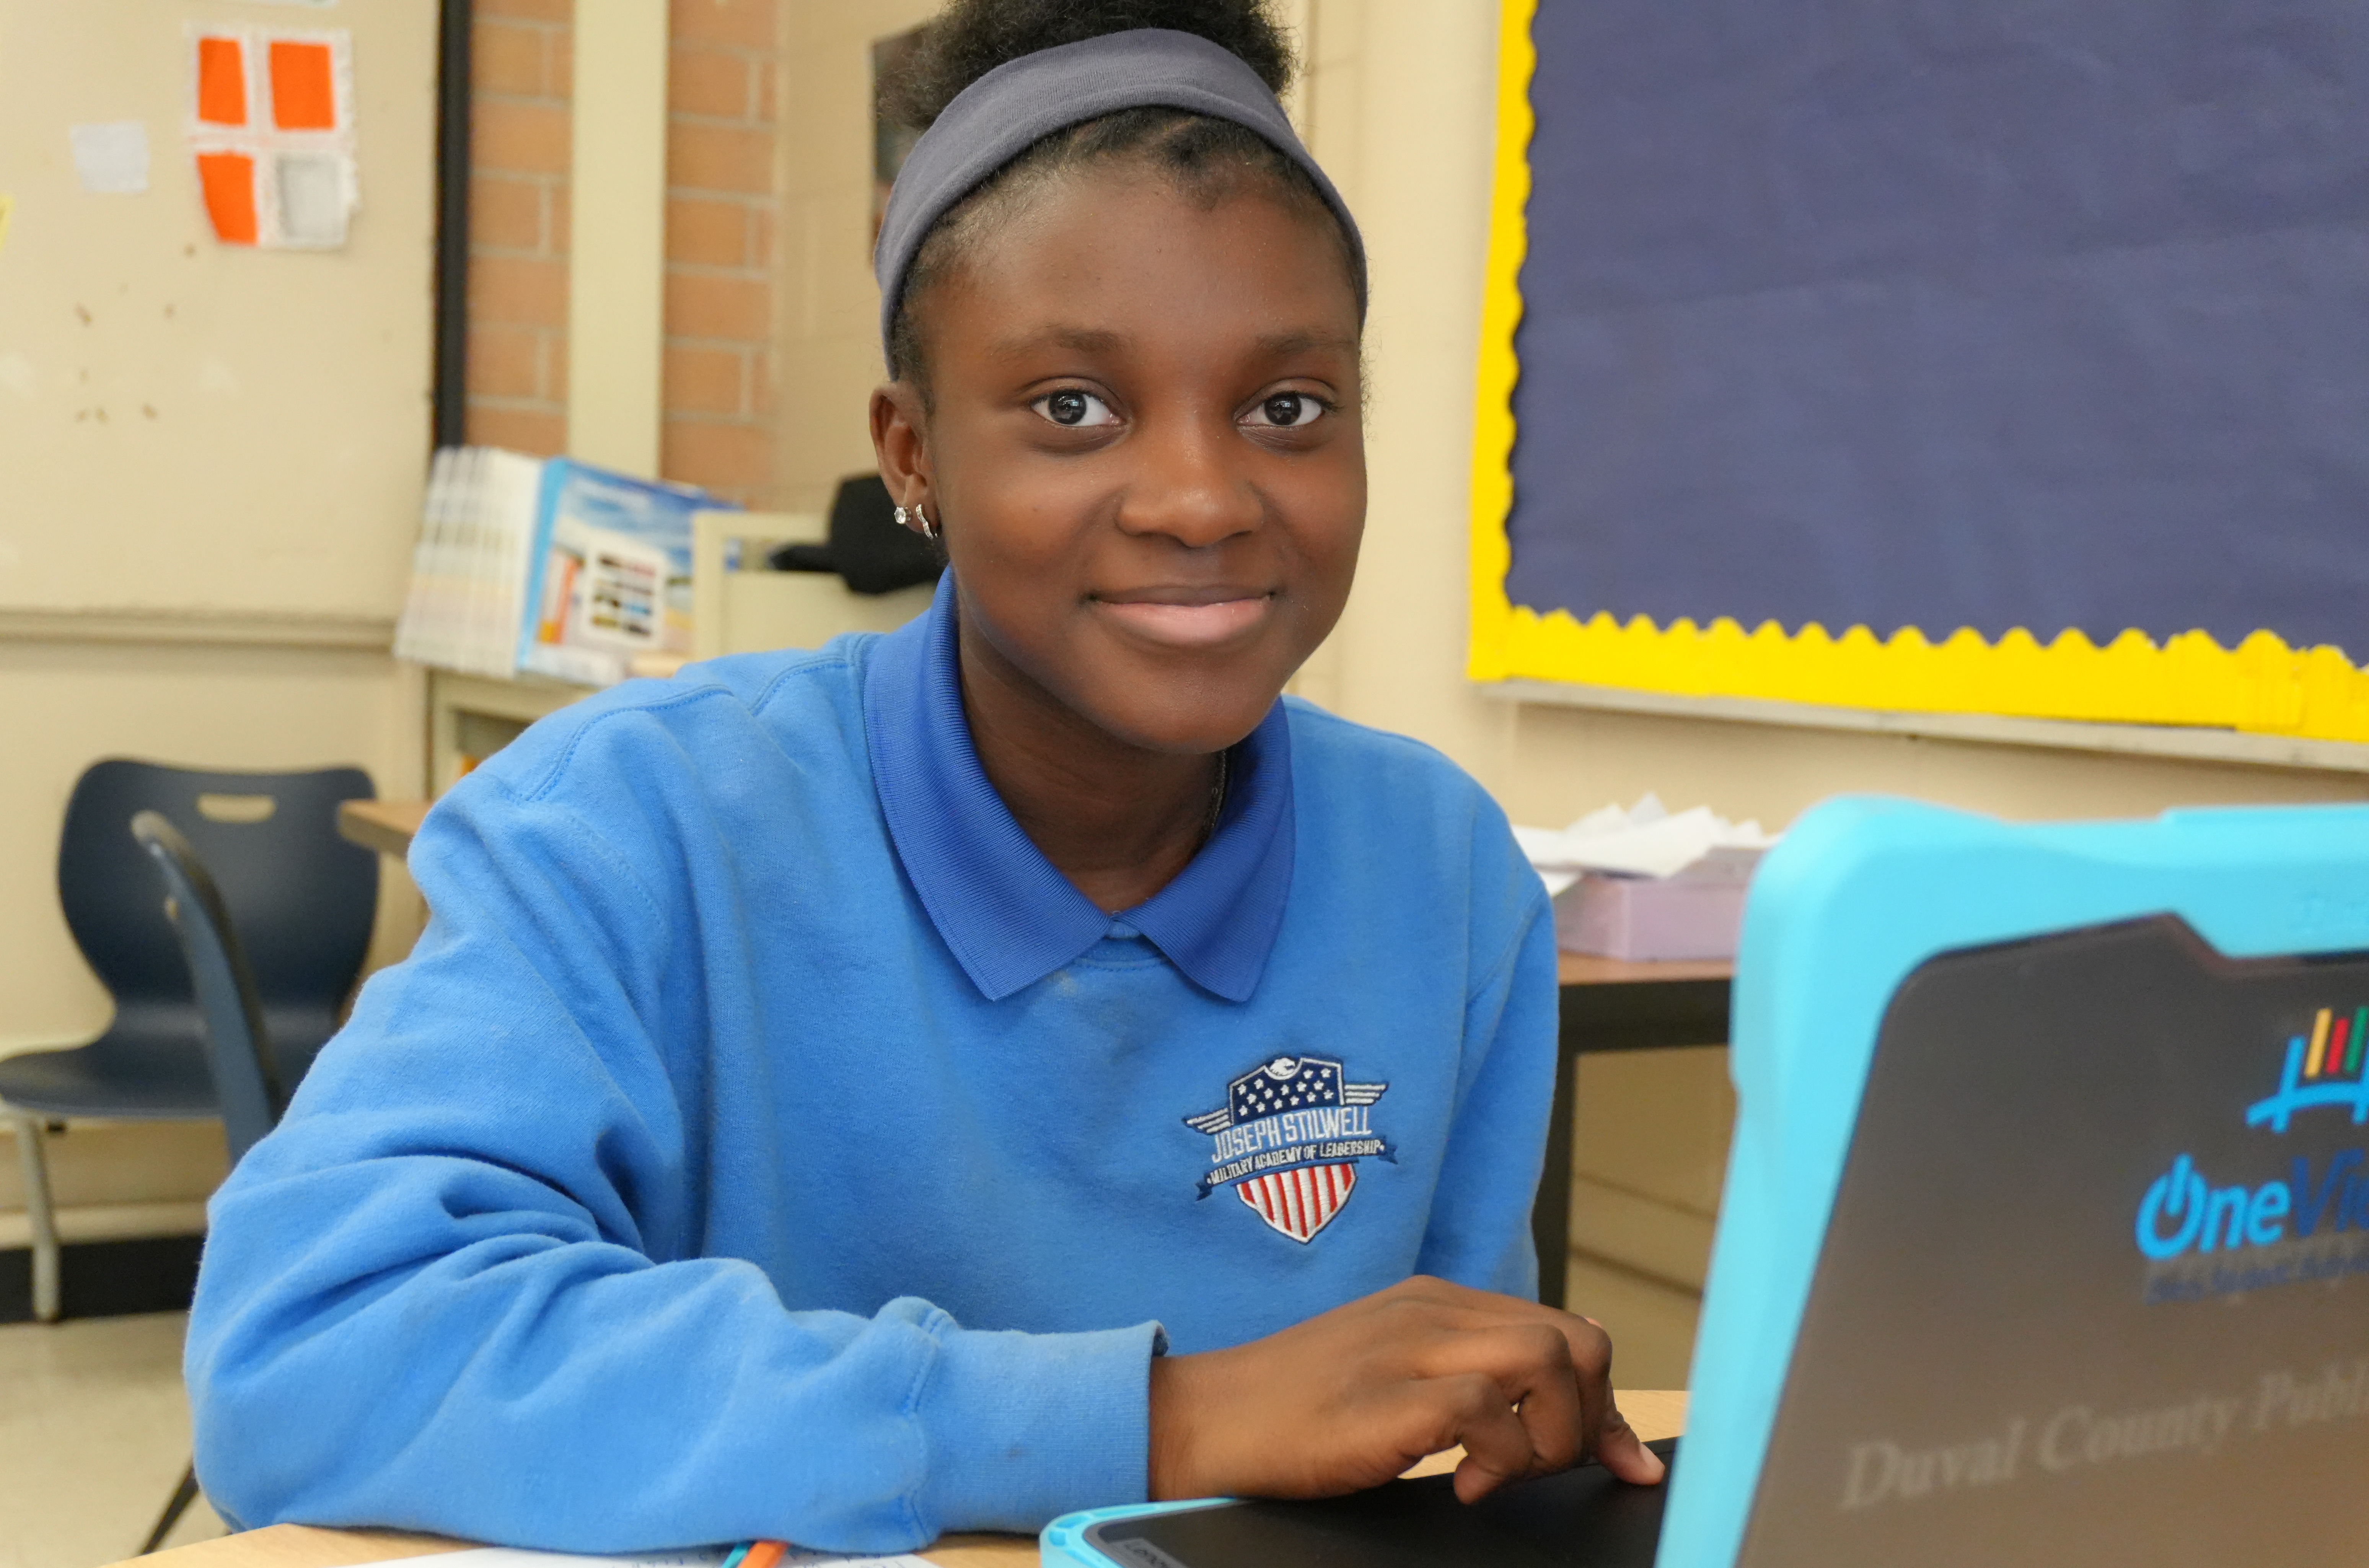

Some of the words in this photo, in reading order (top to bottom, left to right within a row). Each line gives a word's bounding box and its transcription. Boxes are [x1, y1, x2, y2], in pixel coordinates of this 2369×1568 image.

[1210, 1158, 1253, 1184] MILITARY
[1255, 1146, 1302, 1167] ACADEMY
[1303, 1145, 1316, 1160] OF
[1319, 1140, 1380, 1158] LEADERSHIP
[1211, 1117, 1282, 1163] JOSEPH
[1282, 1106, 1372, 1142] STILWELL
[1837, 1415, 2027, 1511] Duval
[2039, 1403, 2243, 1472] County
